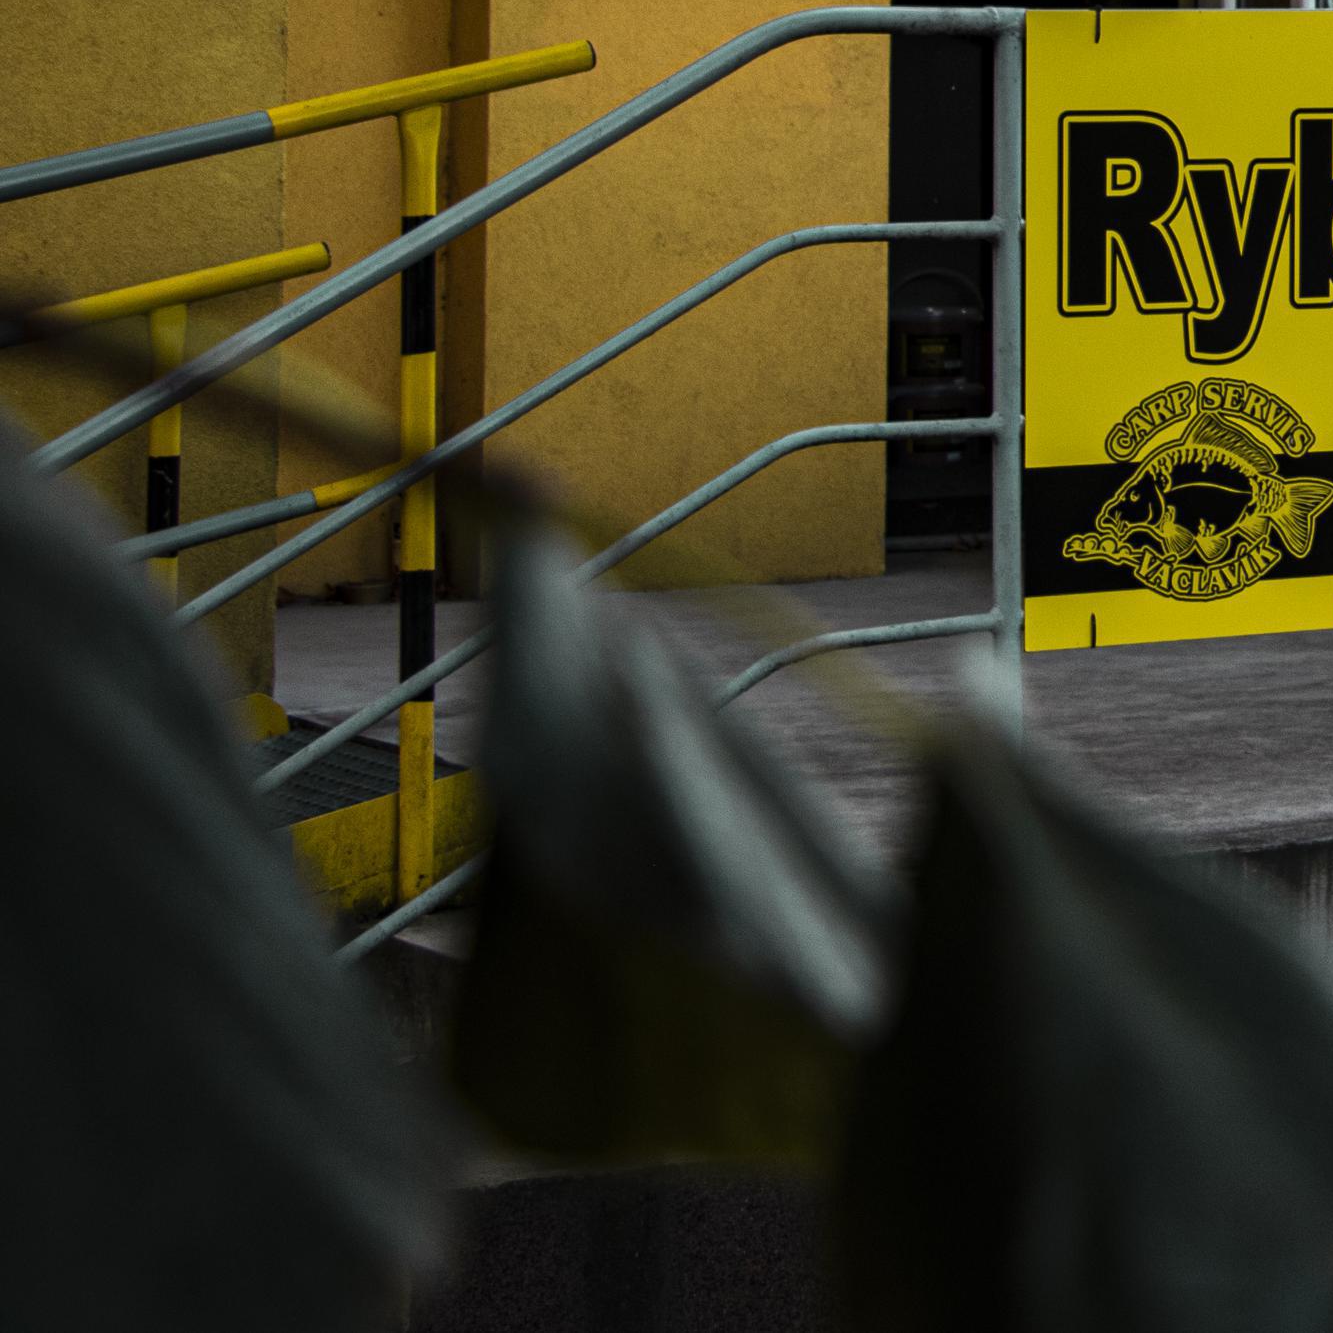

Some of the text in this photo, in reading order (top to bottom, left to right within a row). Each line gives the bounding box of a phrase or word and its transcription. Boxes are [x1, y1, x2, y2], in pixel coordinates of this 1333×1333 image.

[1105, 377, 1316, 462] CARP SERVIS
[1133, 539, 1282, 601] VÁCLAVÍK
